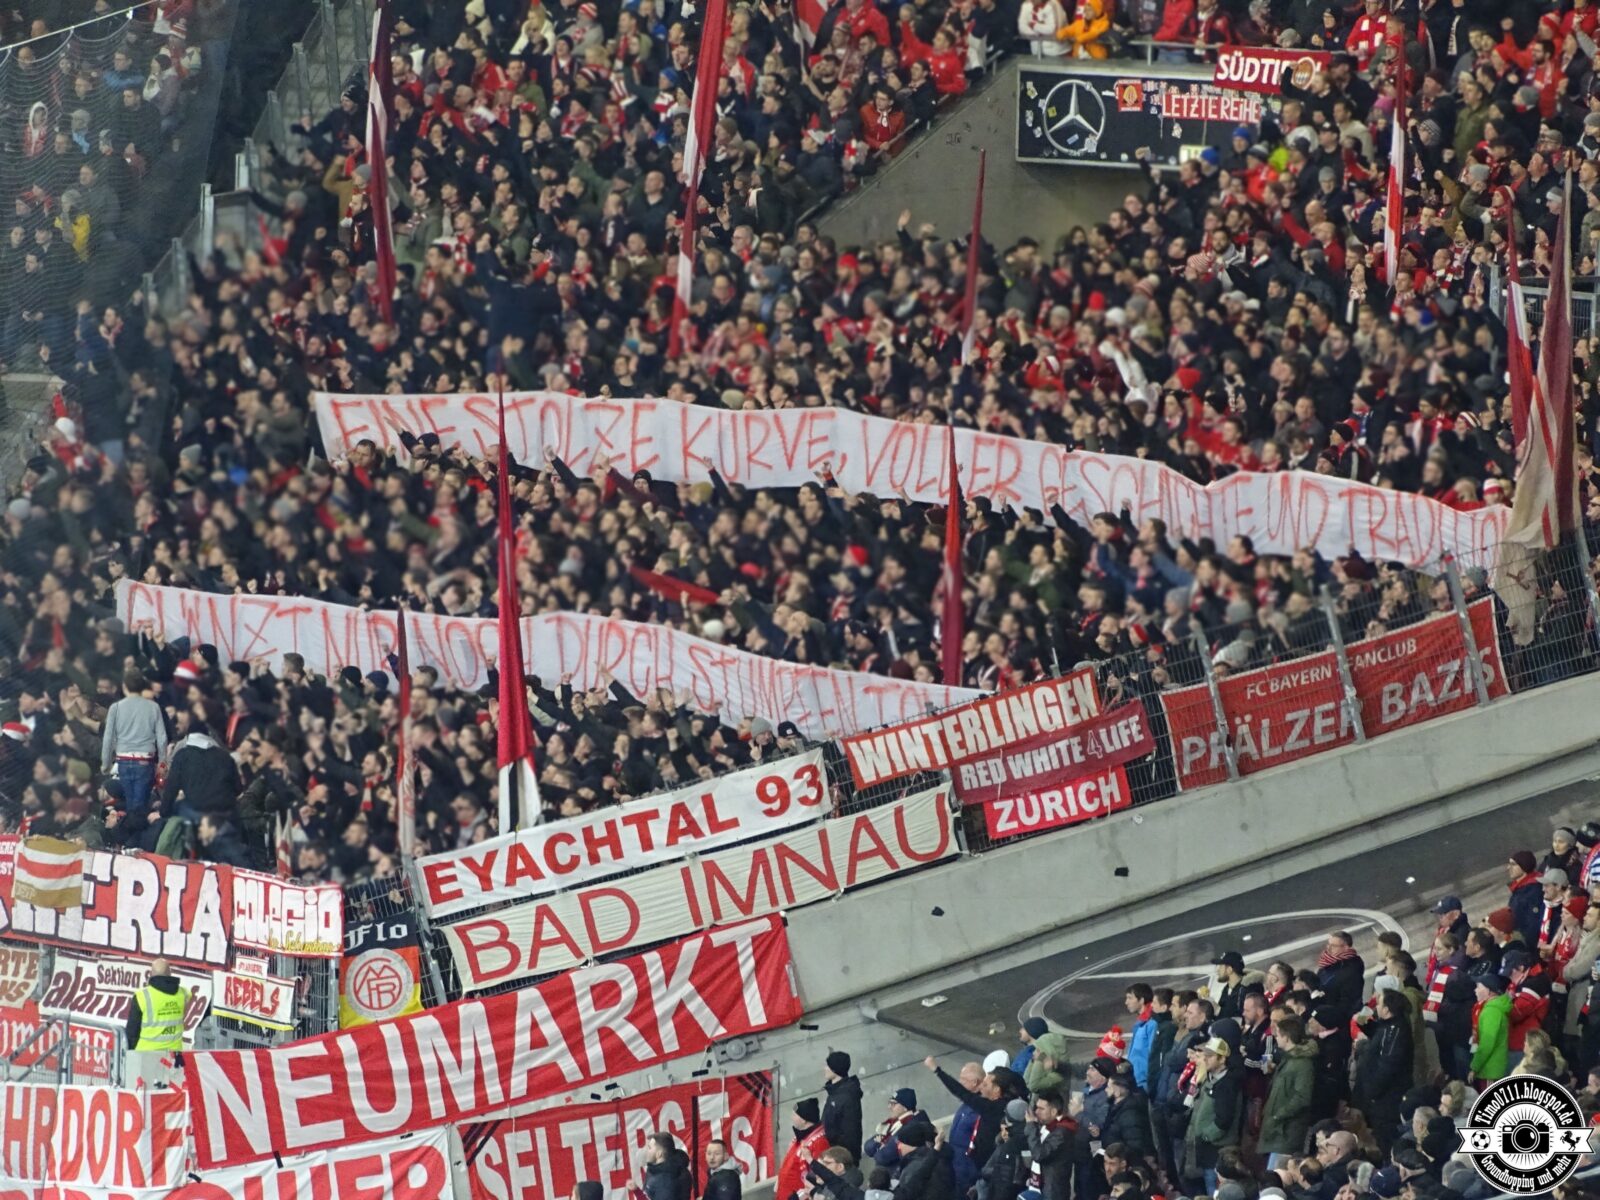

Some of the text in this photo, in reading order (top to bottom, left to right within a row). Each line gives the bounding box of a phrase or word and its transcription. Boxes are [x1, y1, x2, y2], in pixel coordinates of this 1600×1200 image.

[1162, 93, 1218, 119] LETZTE
[464, 397, 660, 476] STOLZE
[862, 418, 1023, 502] VOLLER
[1267, 473, 1330, 550] UND
[848, 673, 1099, 785] WINTERLINGEN
[1246, 681, 1267, 699] FC
[1269, 664, 1332, 693] BAYERN
[959, 757, 1007, 791] RED
[1007, 736, 1086, 780] WHITE
[422, 764, 824, 903] EYACHTAL 93
[453, 792, 949, 983] BAD IMNAU
[97, 964, 140, 988] Sektion
[194, 918, 773, 1163] NEUMARKT
